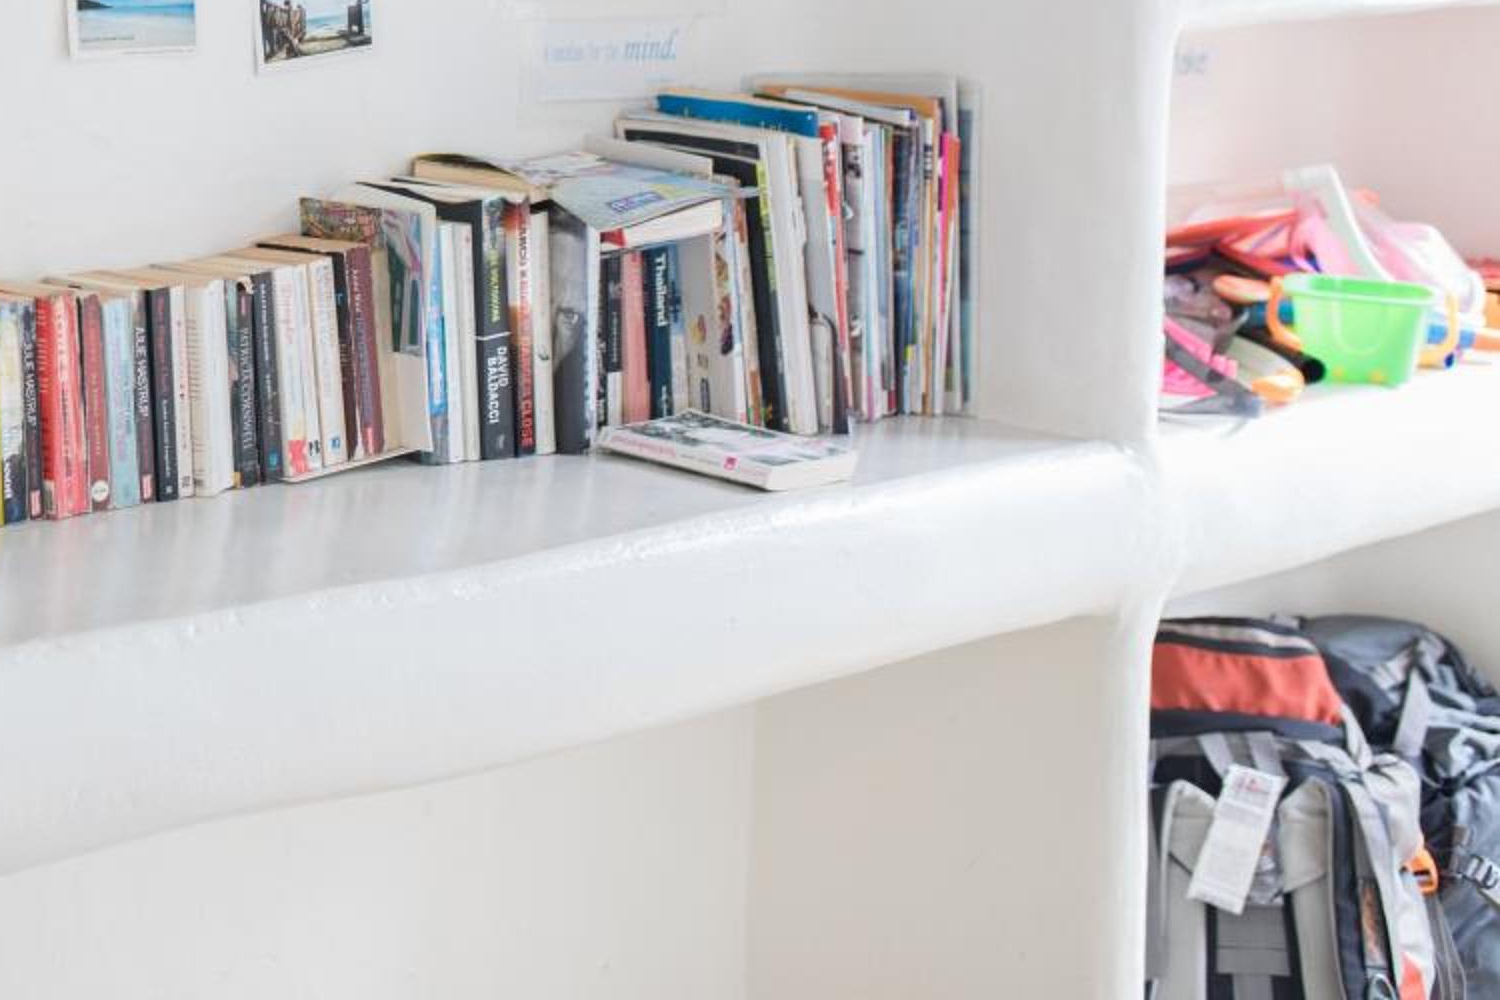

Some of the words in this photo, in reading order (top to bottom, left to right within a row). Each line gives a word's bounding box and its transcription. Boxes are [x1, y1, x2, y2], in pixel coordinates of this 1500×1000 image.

[654, 252, 668, 327] Thailand
[487, 356, 500, 425] BALDACCI
[497, 345, 509, 386] DAVID
[521, 400, 534, 448] CLOSE
